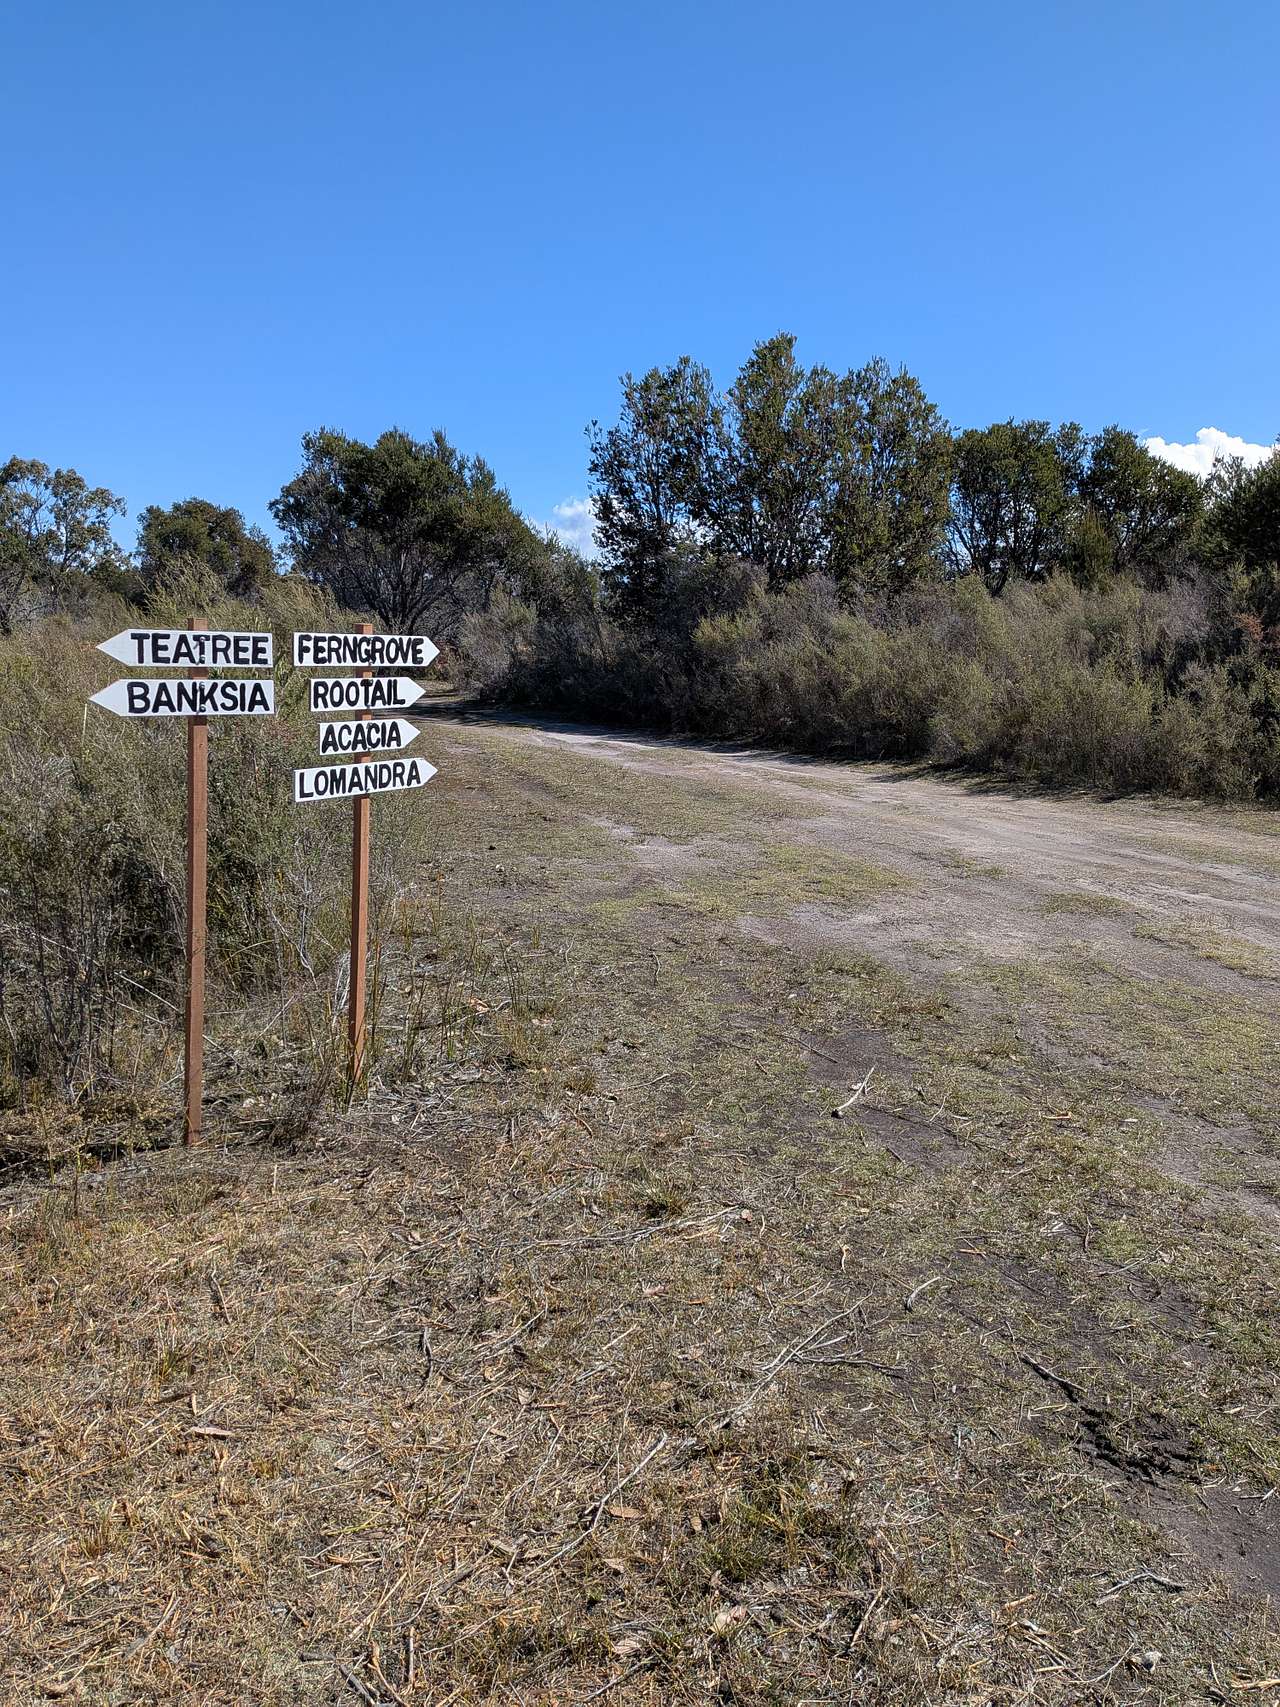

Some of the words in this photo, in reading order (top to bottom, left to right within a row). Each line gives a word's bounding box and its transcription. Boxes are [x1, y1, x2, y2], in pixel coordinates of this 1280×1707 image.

[130, 632, 269, 665] TEATREE
[298, 634, 424, 664] FERNGROVE
[127, 681, 270, 714] BANKSIA
[313, 679, 406, 709] ROOTAIL
[321, 721, 402, 754] ACACIA
[299, 760, 421, 798] LOMANDRA
